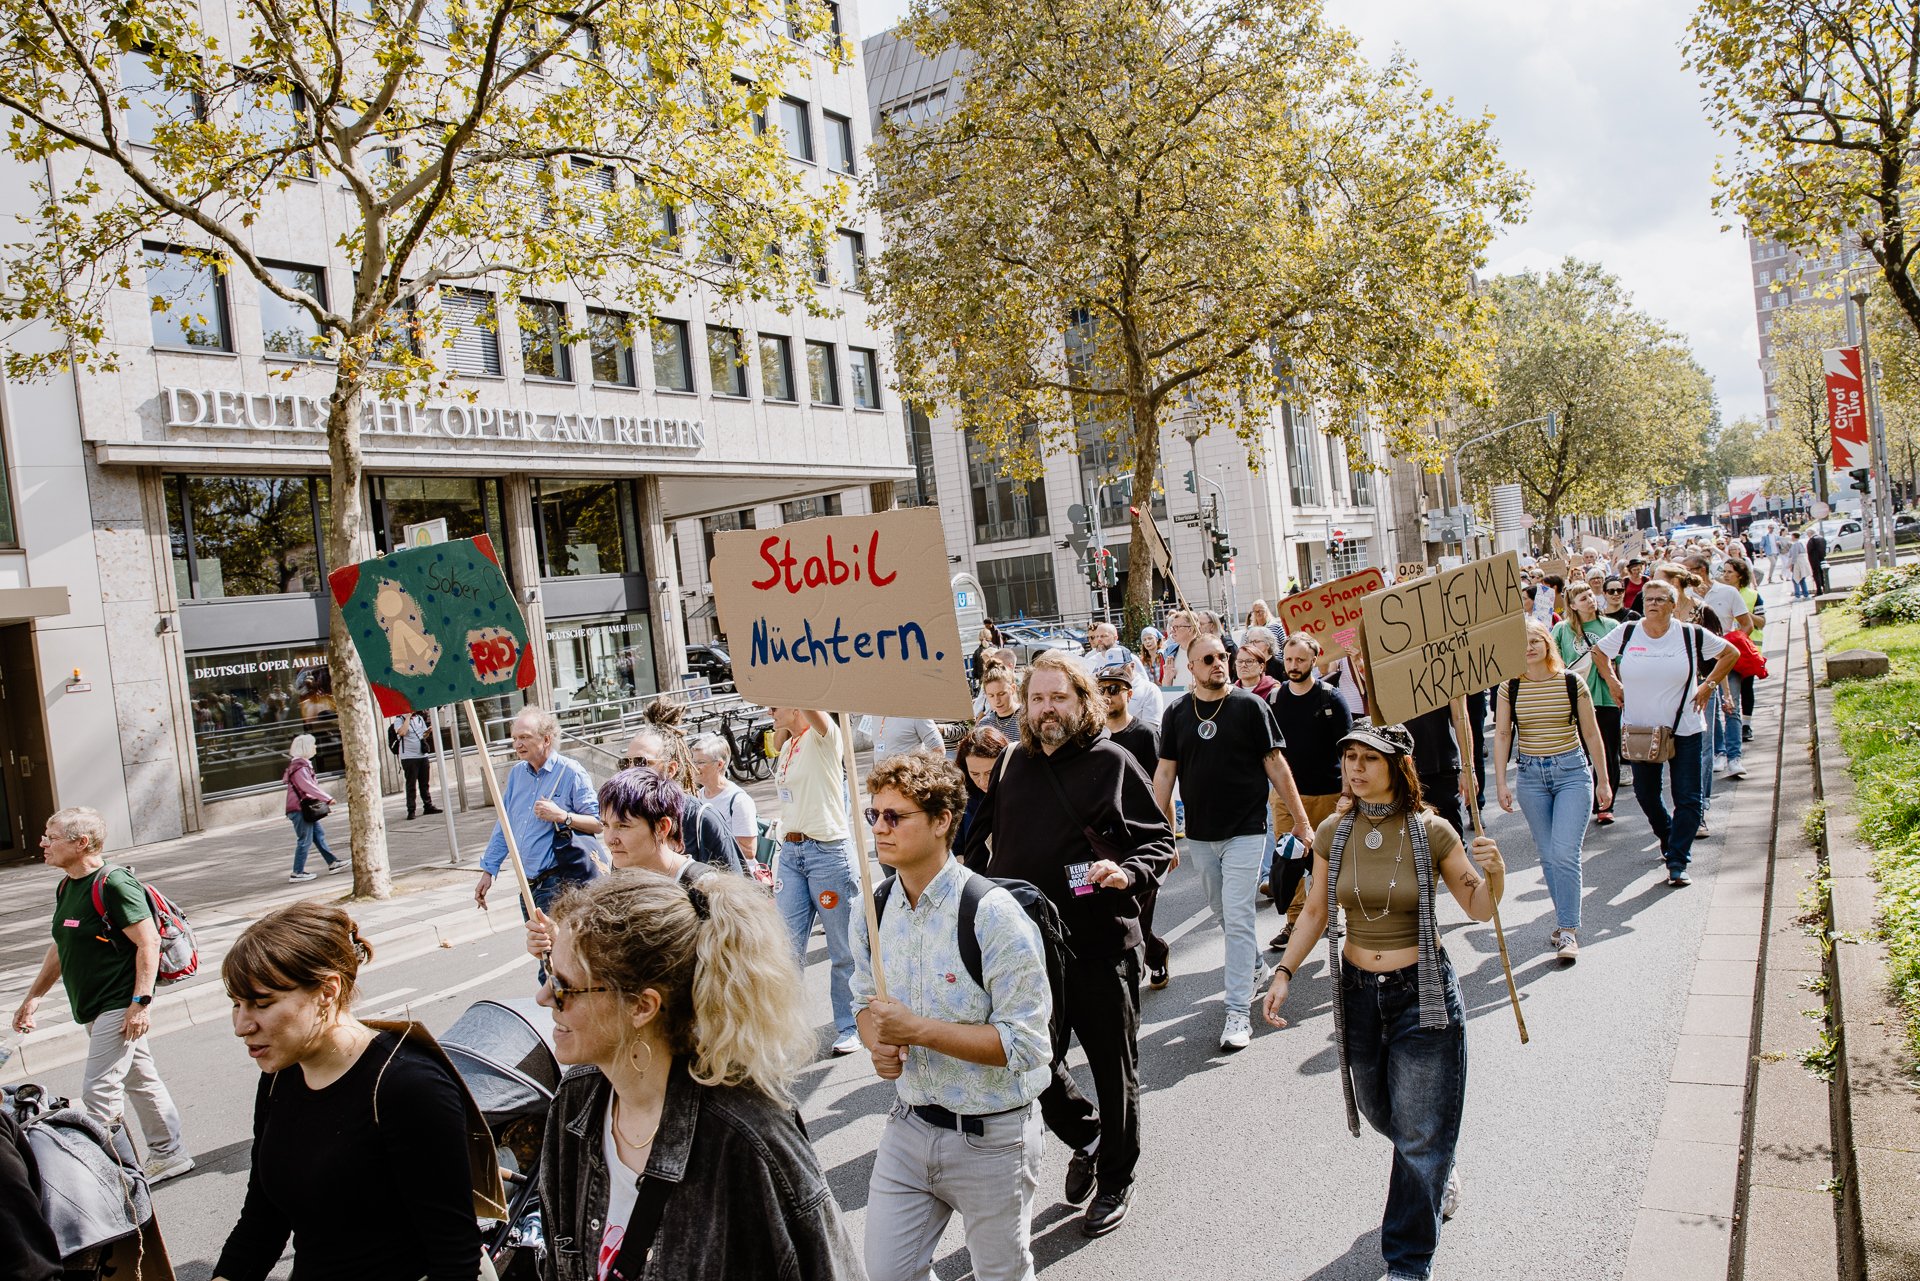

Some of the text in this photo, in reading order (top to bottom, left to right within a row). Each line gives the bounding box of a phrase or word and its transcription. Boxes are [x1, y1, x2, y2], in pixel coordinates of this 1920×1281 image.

[1832, 387, 1849, 429] City of
[1848, 390, 1861, 417] Live
[439, 404, 542, 441] OPER
[551, 410, 607, 443] AM
[611, 414, 707, 448] RHEIN
[752, 529, 897, 594] Stabil
[426, 562, 480, 600] Sober
[1290, 580, 1377, 618] no shame
[1379, 559, 1524, 654] STIGMA
[546, 628, 586, 641] DEUTSCHE
[608, 624, 620, 634] AM
[620, 622, 643, 633] RHEIN
[750, 616, 945, 667] Nüchtern.
[1300, 619, 1326, 634] no
[1421, 628, 1469, 663] macht
[194, 662, 258, 680] DEUTSCHE
[258, 658, 290, 672] OPER
[292, 656, 310, 669] AM
[1409, 644, 1502, 714] KRANK
[1069, 863, 1090, 875] KEINE
